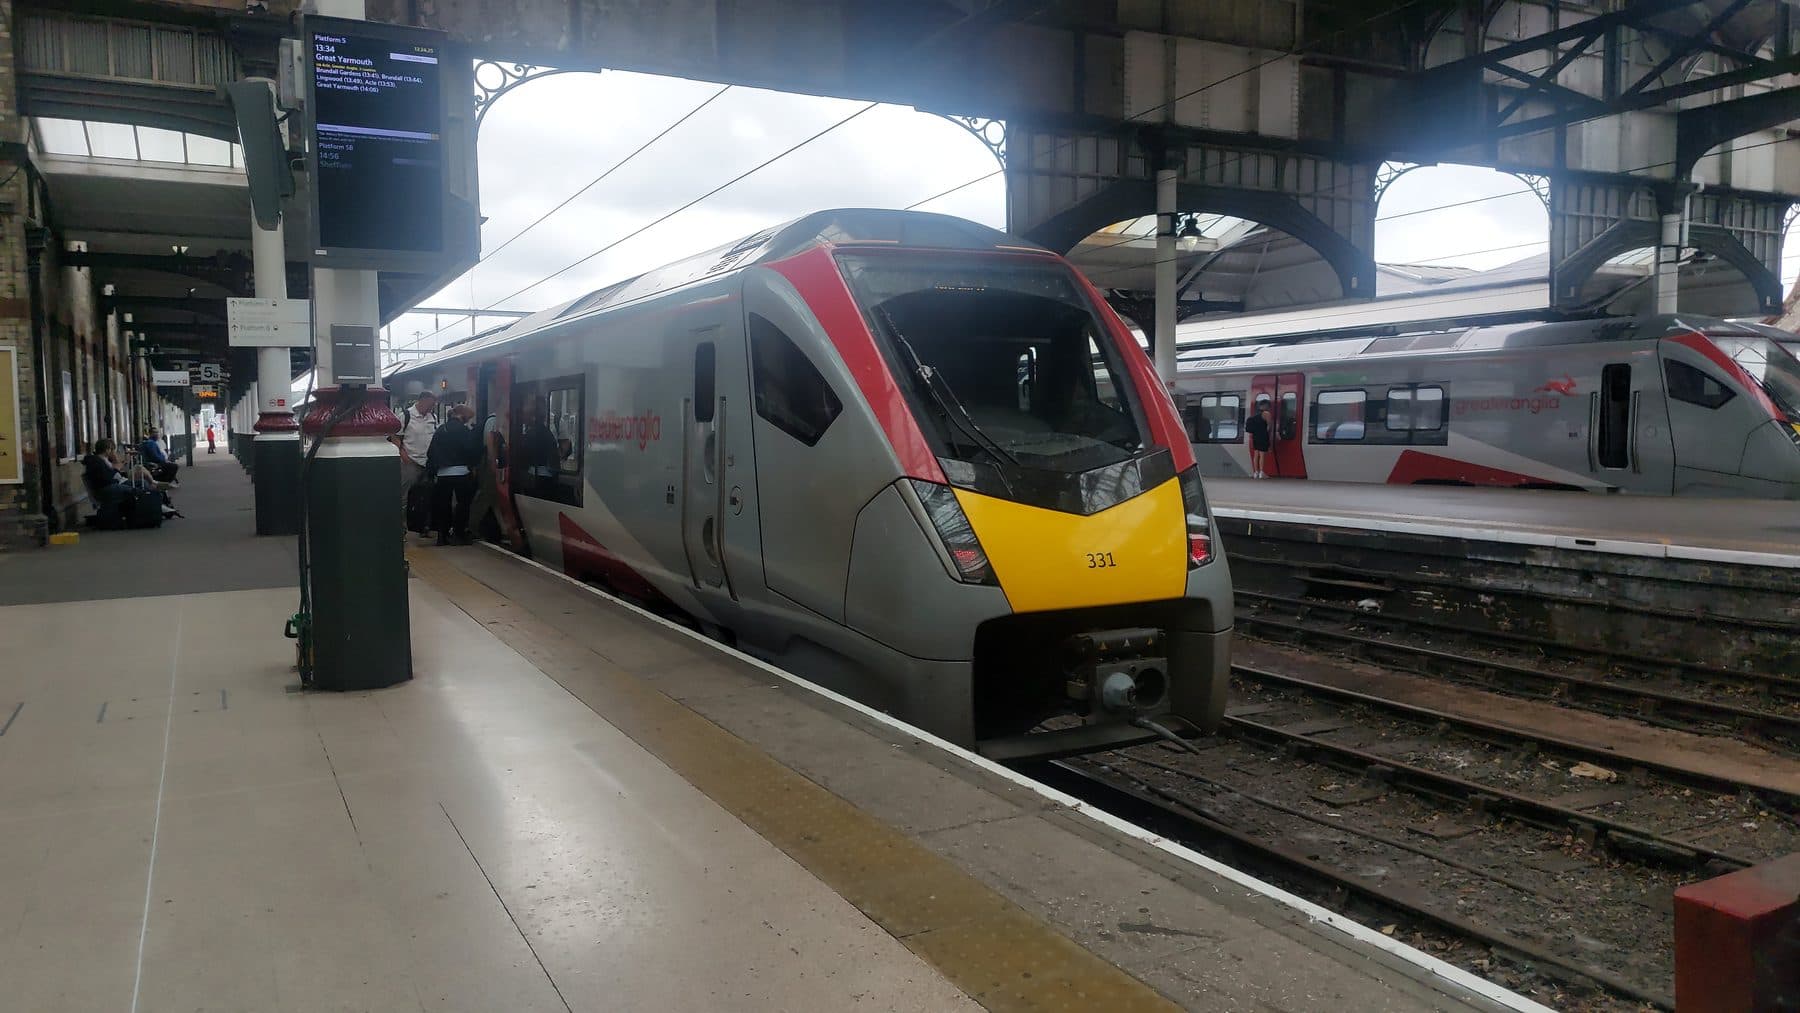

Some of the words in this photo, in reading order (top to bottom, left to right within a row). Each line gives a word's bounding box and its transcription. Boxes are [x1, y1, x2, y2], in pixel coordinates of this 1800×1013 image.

[315, 34, 341, 43] Platform
[315, 44, 335, 53] 13:34
[315, 53, 337, 62] Great
[337, 55, 373, 66] Yarmouth
[339, 69, 362, 77] Gardens
[381, 73, 403, 81] Brundall
[333, 83, 360, 91] Yarmouth
[318, 142, 345, 150] Platform
[1086, 552, 1117, 569] 331
